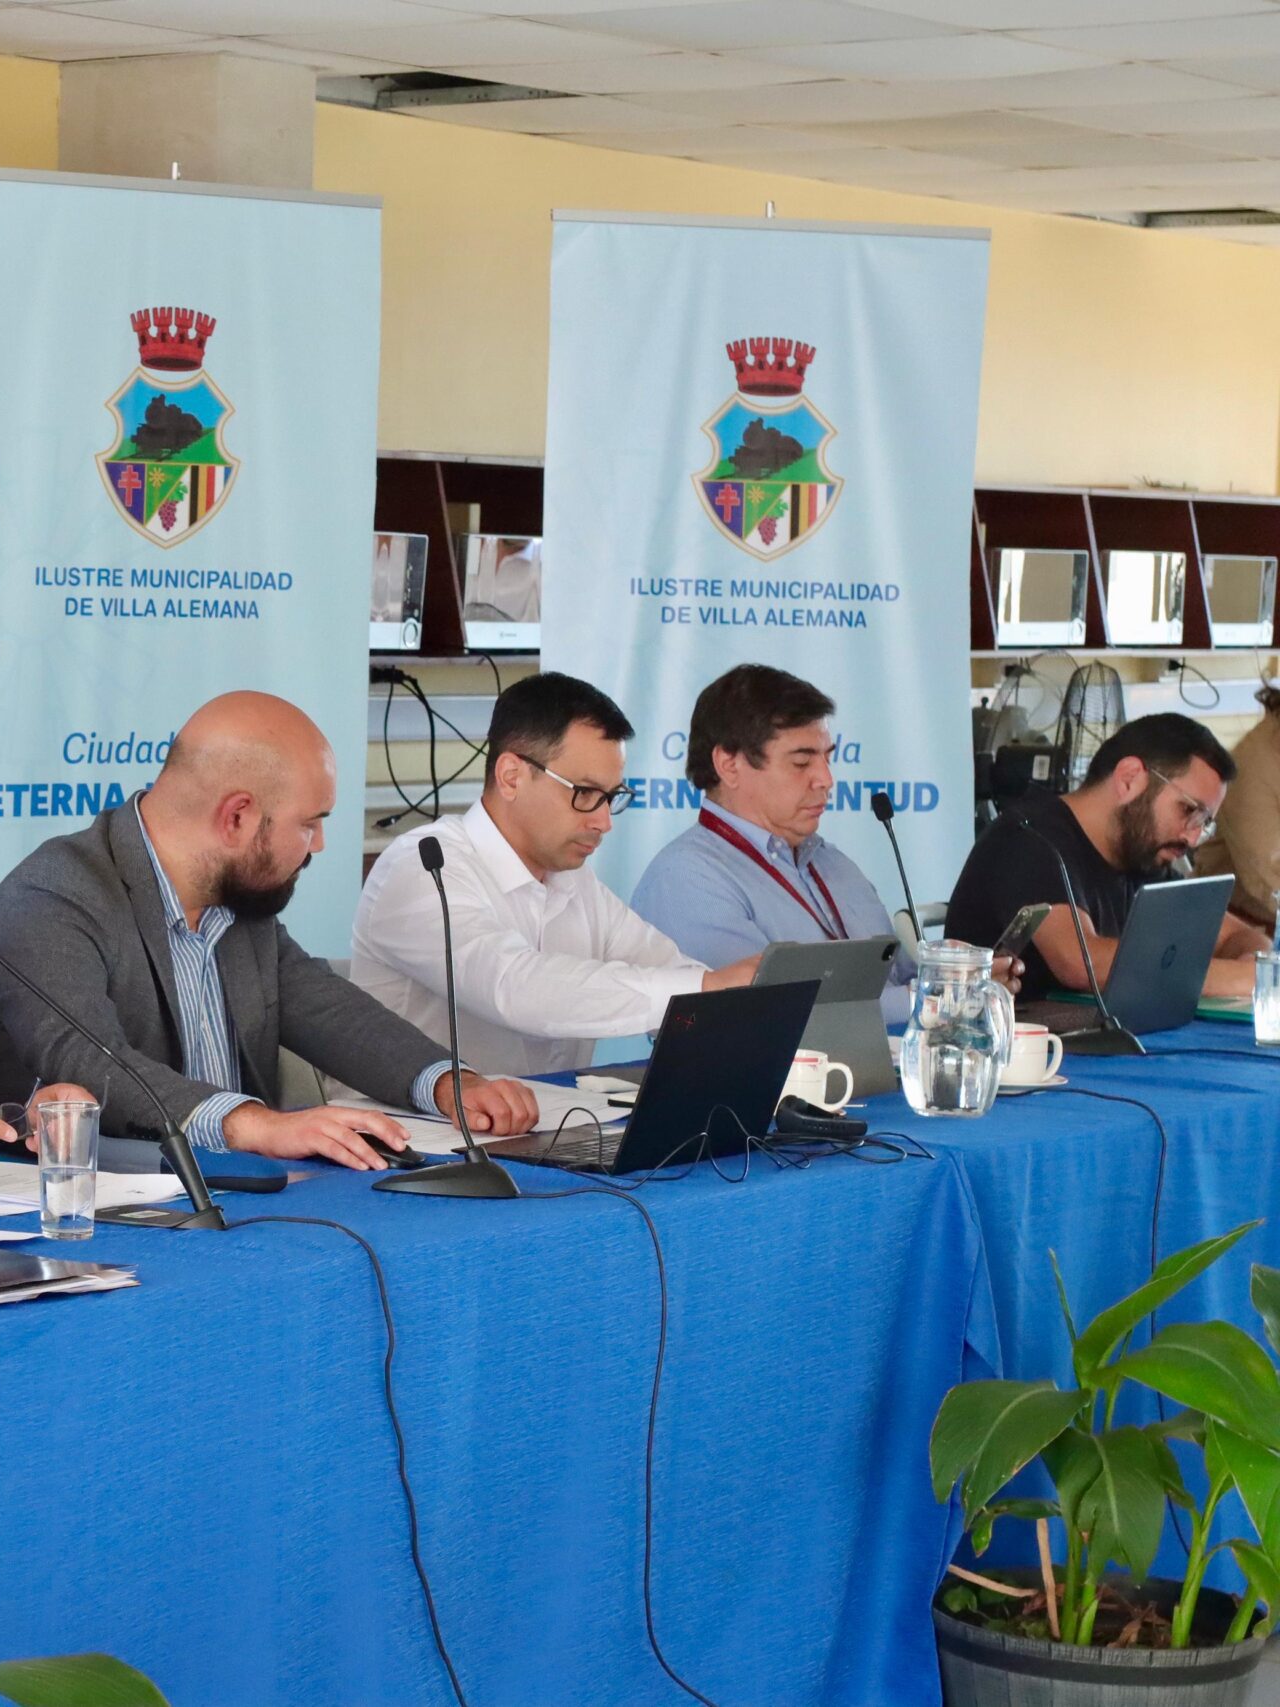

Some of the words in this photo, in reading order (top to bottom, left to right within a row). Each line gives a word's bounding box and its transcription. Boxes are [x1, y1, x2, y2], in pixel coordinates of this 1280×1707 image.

[35, 567, 124, 587] ILUSTRE
[130, 568, 293, 591] MUNICIPALIDAD
[631, 577, 723, 597] ILUSTRE
[730, 579, 899, 601] MUNICIPALIDAD
[64, 597, 94, 617] DE
[100, 597, 157, 618] VILLA
[162, 598, 259, 619] ALEMANA
[661, 605, 691, 624] DE
[698, 606, 758, 626] VILLA
[763, 608, 867, 629] ALEMANA
